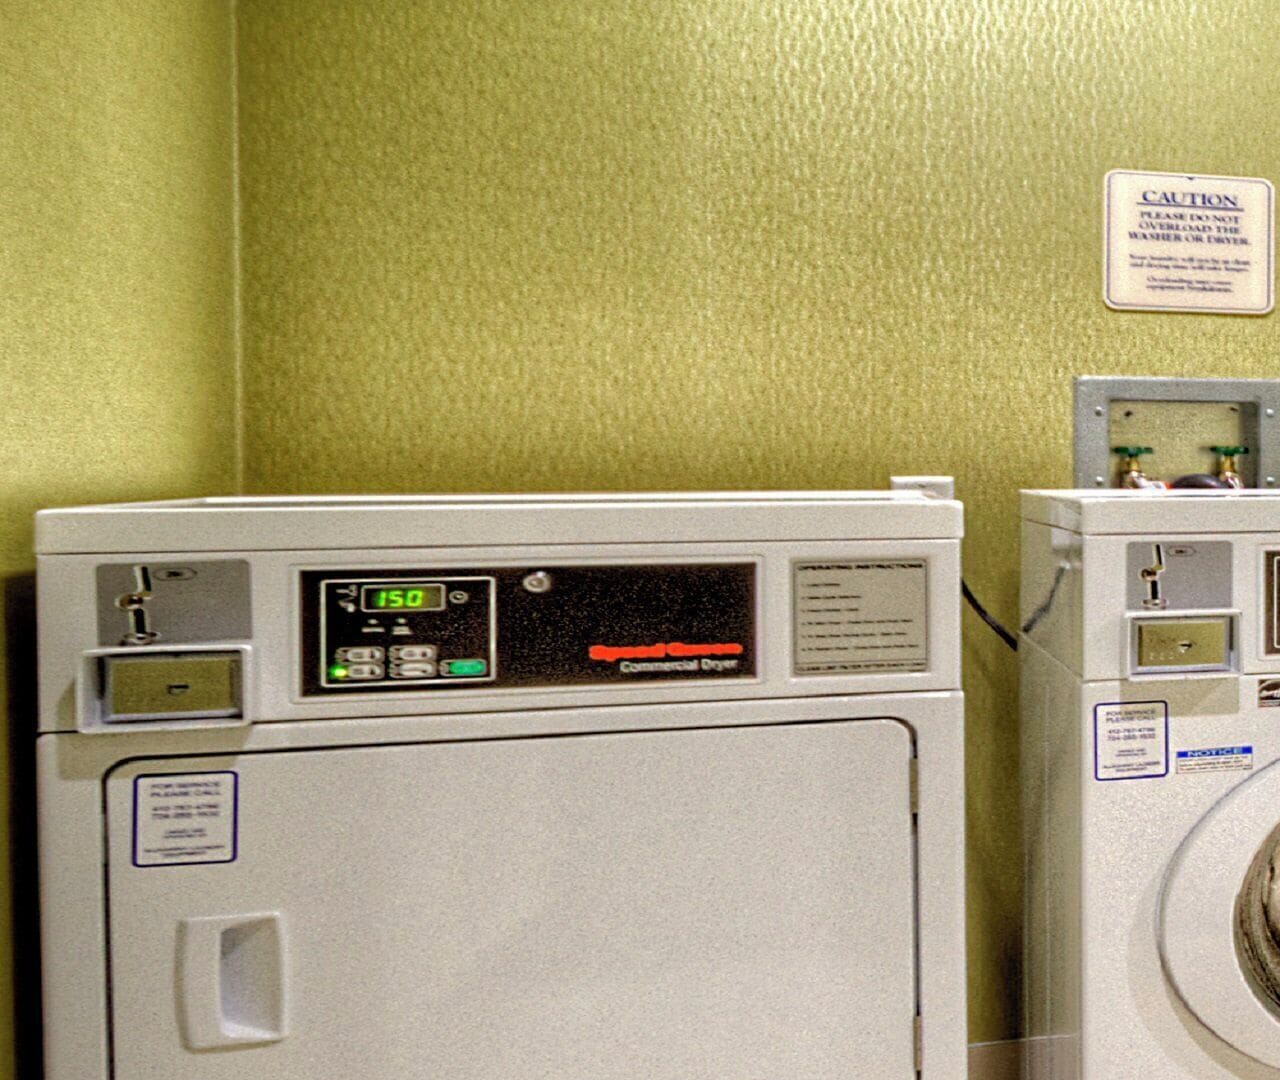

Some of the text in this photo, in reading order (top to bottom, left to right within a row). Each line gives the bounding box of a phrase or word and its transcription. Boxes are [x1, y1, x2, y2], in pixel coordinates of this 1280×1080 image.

[1142, 190, 1238, 207] CAUTION
[1140, 211, 1240, 225] PLEASE DO NOT
[1138, 220, 1241, 234] OVERLOAD THE
[1128, 231, 1251, 246] WASHER OR DRYER.
[379, 590, 424, 608] 150
[619, 658, 738, 673] Commercial Dryer
[1188, 747, 1242, 758] NOTICE
